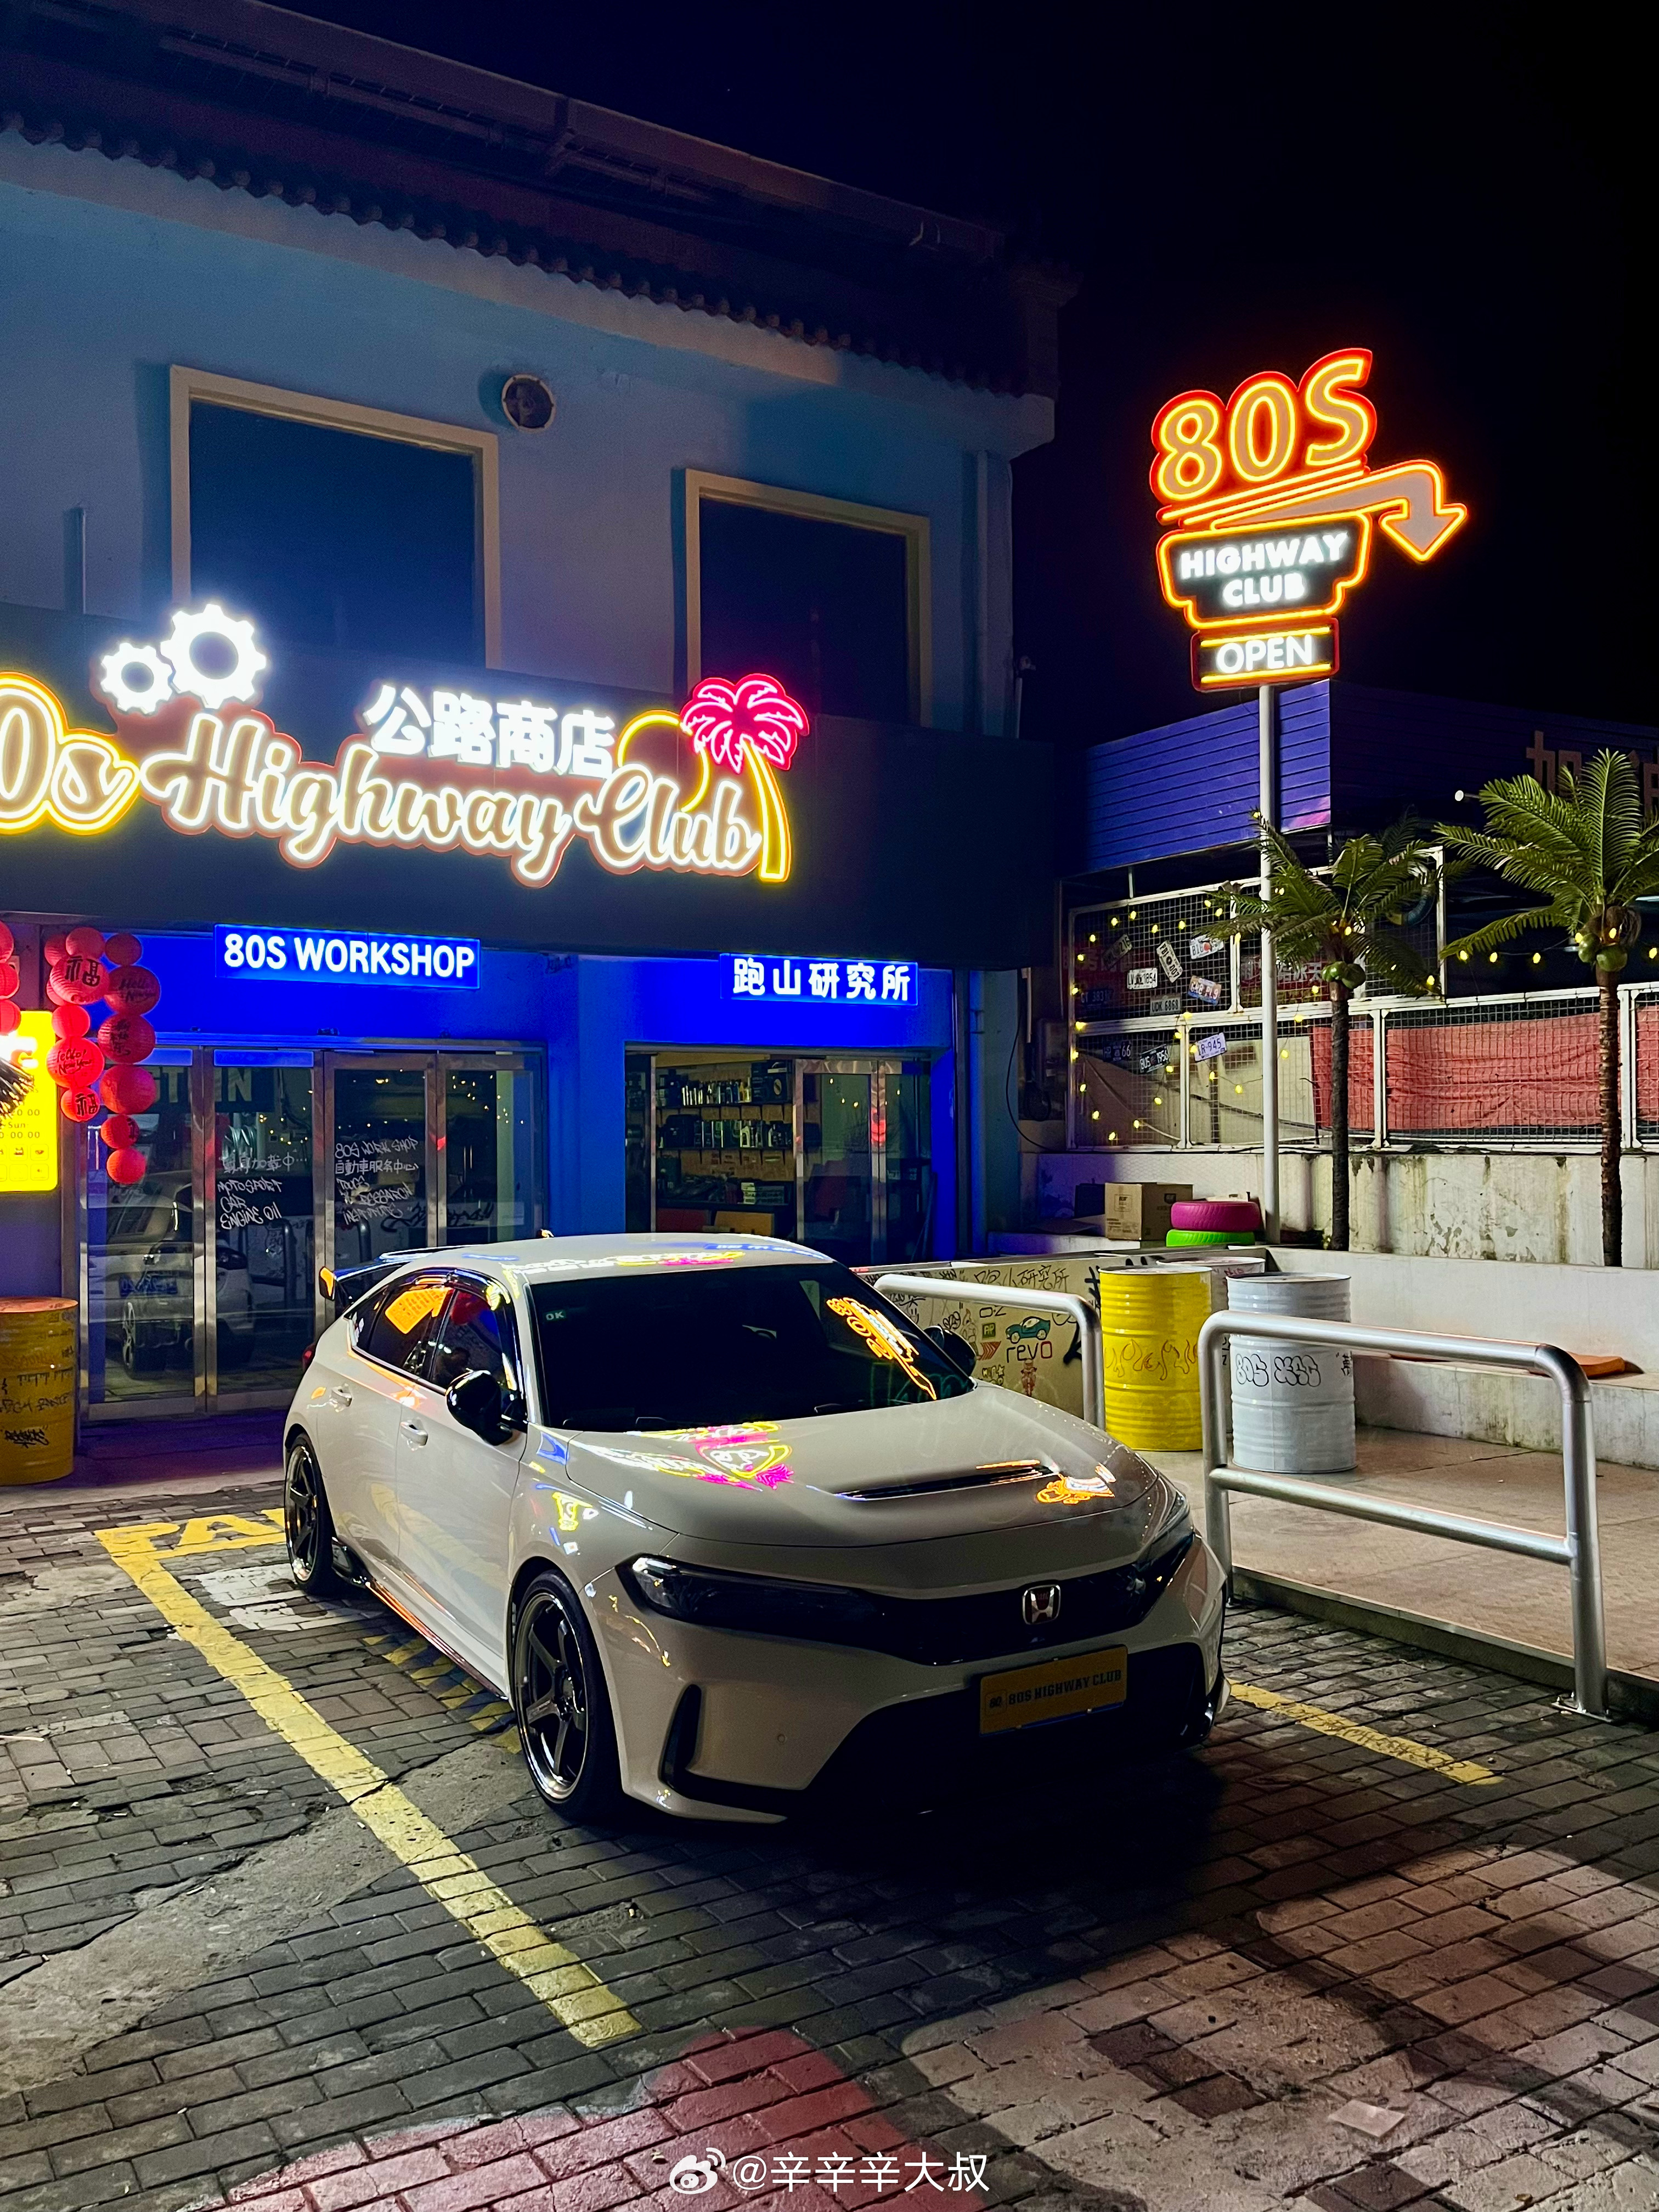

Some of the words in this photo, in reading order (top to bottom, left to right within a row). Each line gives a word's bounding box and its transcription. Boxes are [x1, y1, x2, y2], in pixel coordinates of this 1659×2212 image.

[1156, 357, 1370, 501] 80S
[1180, 530, 1350, 580] HIGHWAY
[1222, 572, 1306, 608] CLUB
[1215, 633, 1314, 674] OPEN
[362, 684, 616, 779] 公路商店
[141, 712, 573, 882] Highway
[574, 763, 761, 871] Club
[224, 933, 286, 969] 80S
[294, 936, 475, 979] WORKSHOP
[732, 958, 911, 1001] 跑山研究所
[545, 1311, 565, 1321] OK
[1008, 1690, 1032, 1705] 80S
[1034, 1675, 1090, 1700] HIGHWAY
[1092, 1669, 1122, 1686] CLUB
